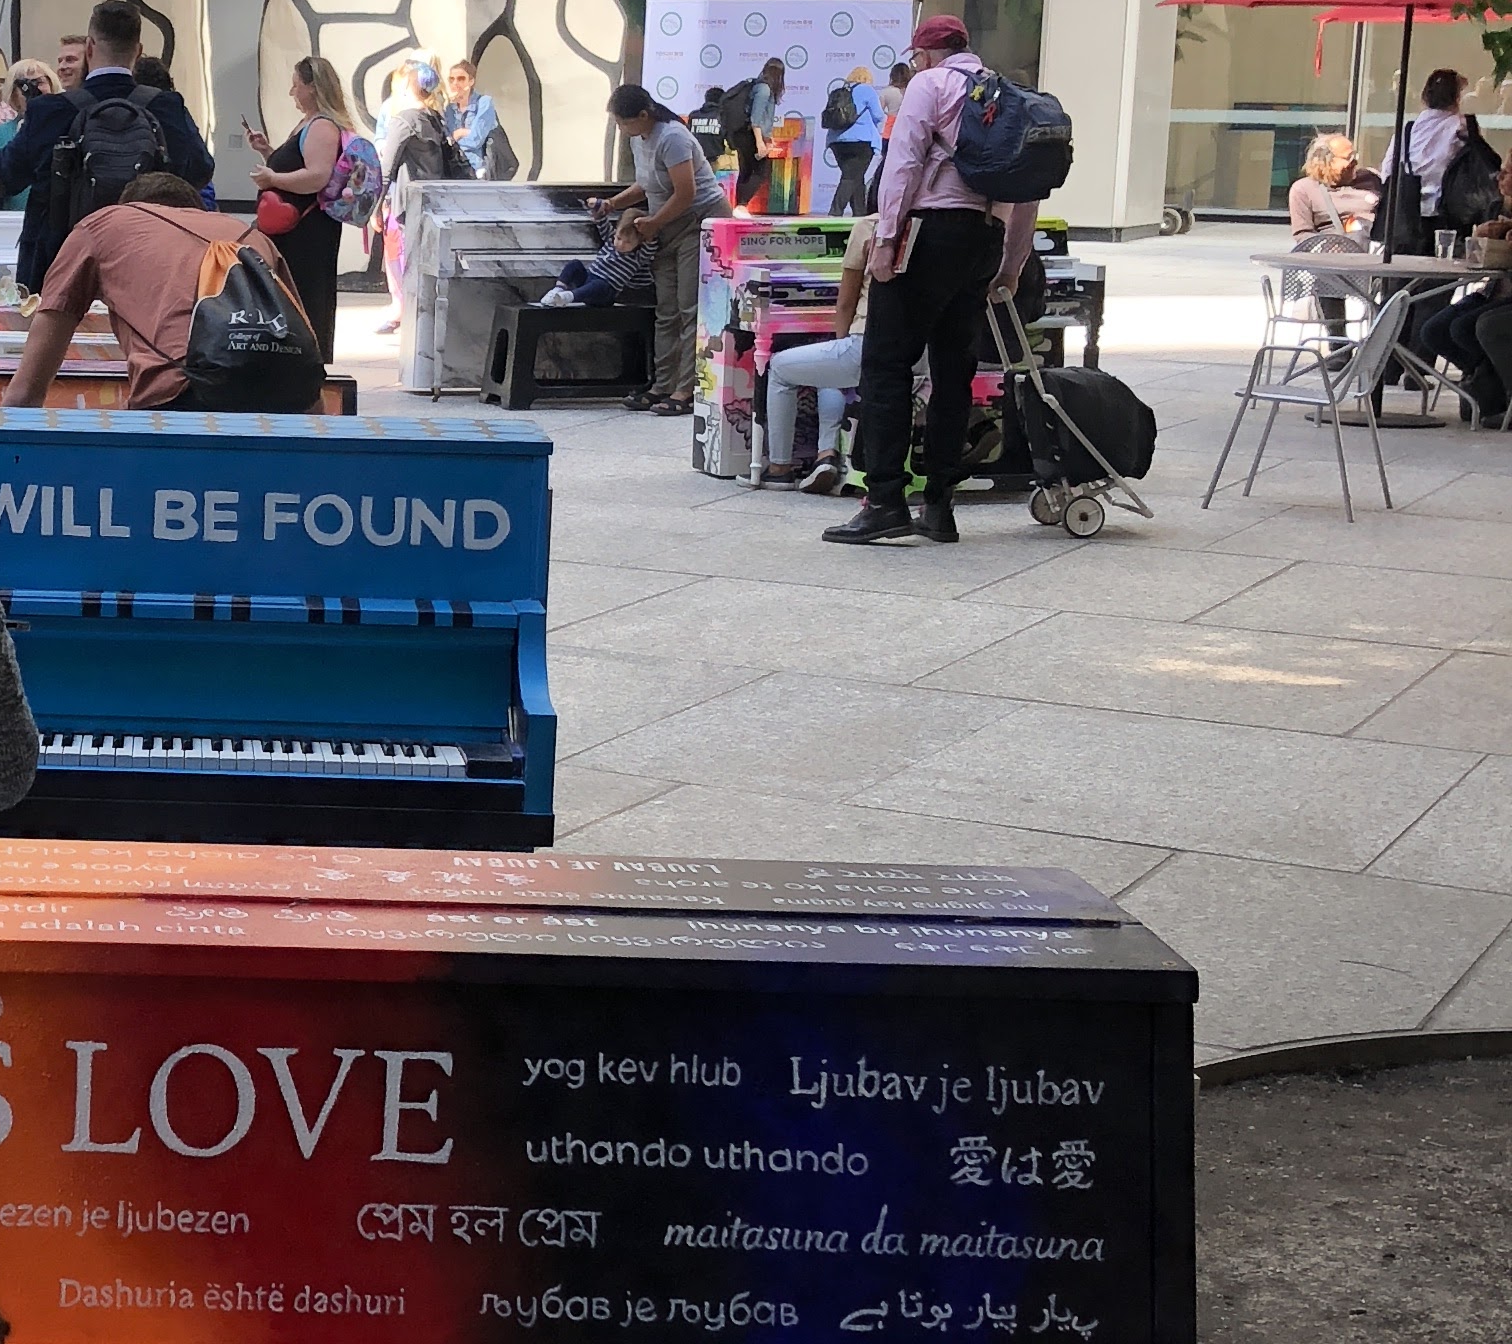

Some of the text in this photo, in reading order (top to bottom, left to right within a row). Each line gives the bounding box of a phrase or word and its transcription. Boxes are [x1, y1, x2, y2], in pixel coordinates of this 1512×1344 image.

[740, 236, 824, 246] SING FOR HOPE
[153, 489, 240, 541] BE
[263, 492, 513, 552] FOUND
[521, 1052, 742, 1088] yog kev hlub
[789, 1056, 1105, 1114] Ljubav je ljubav
[61, 1040, 455, 1165] LOVE
[525, 1132, 870, 1175] uthando uthando
[949, 1135, 1097, 1190] 愛は愛
[76, 1199, 111, 1237] je
[116, 1199, 250, 1236] ljubezen
[663, 1203, 1105, 1262] maitasuna da maitasuna
[59, 1278, 406, 1317] Dashuria është dashuri
